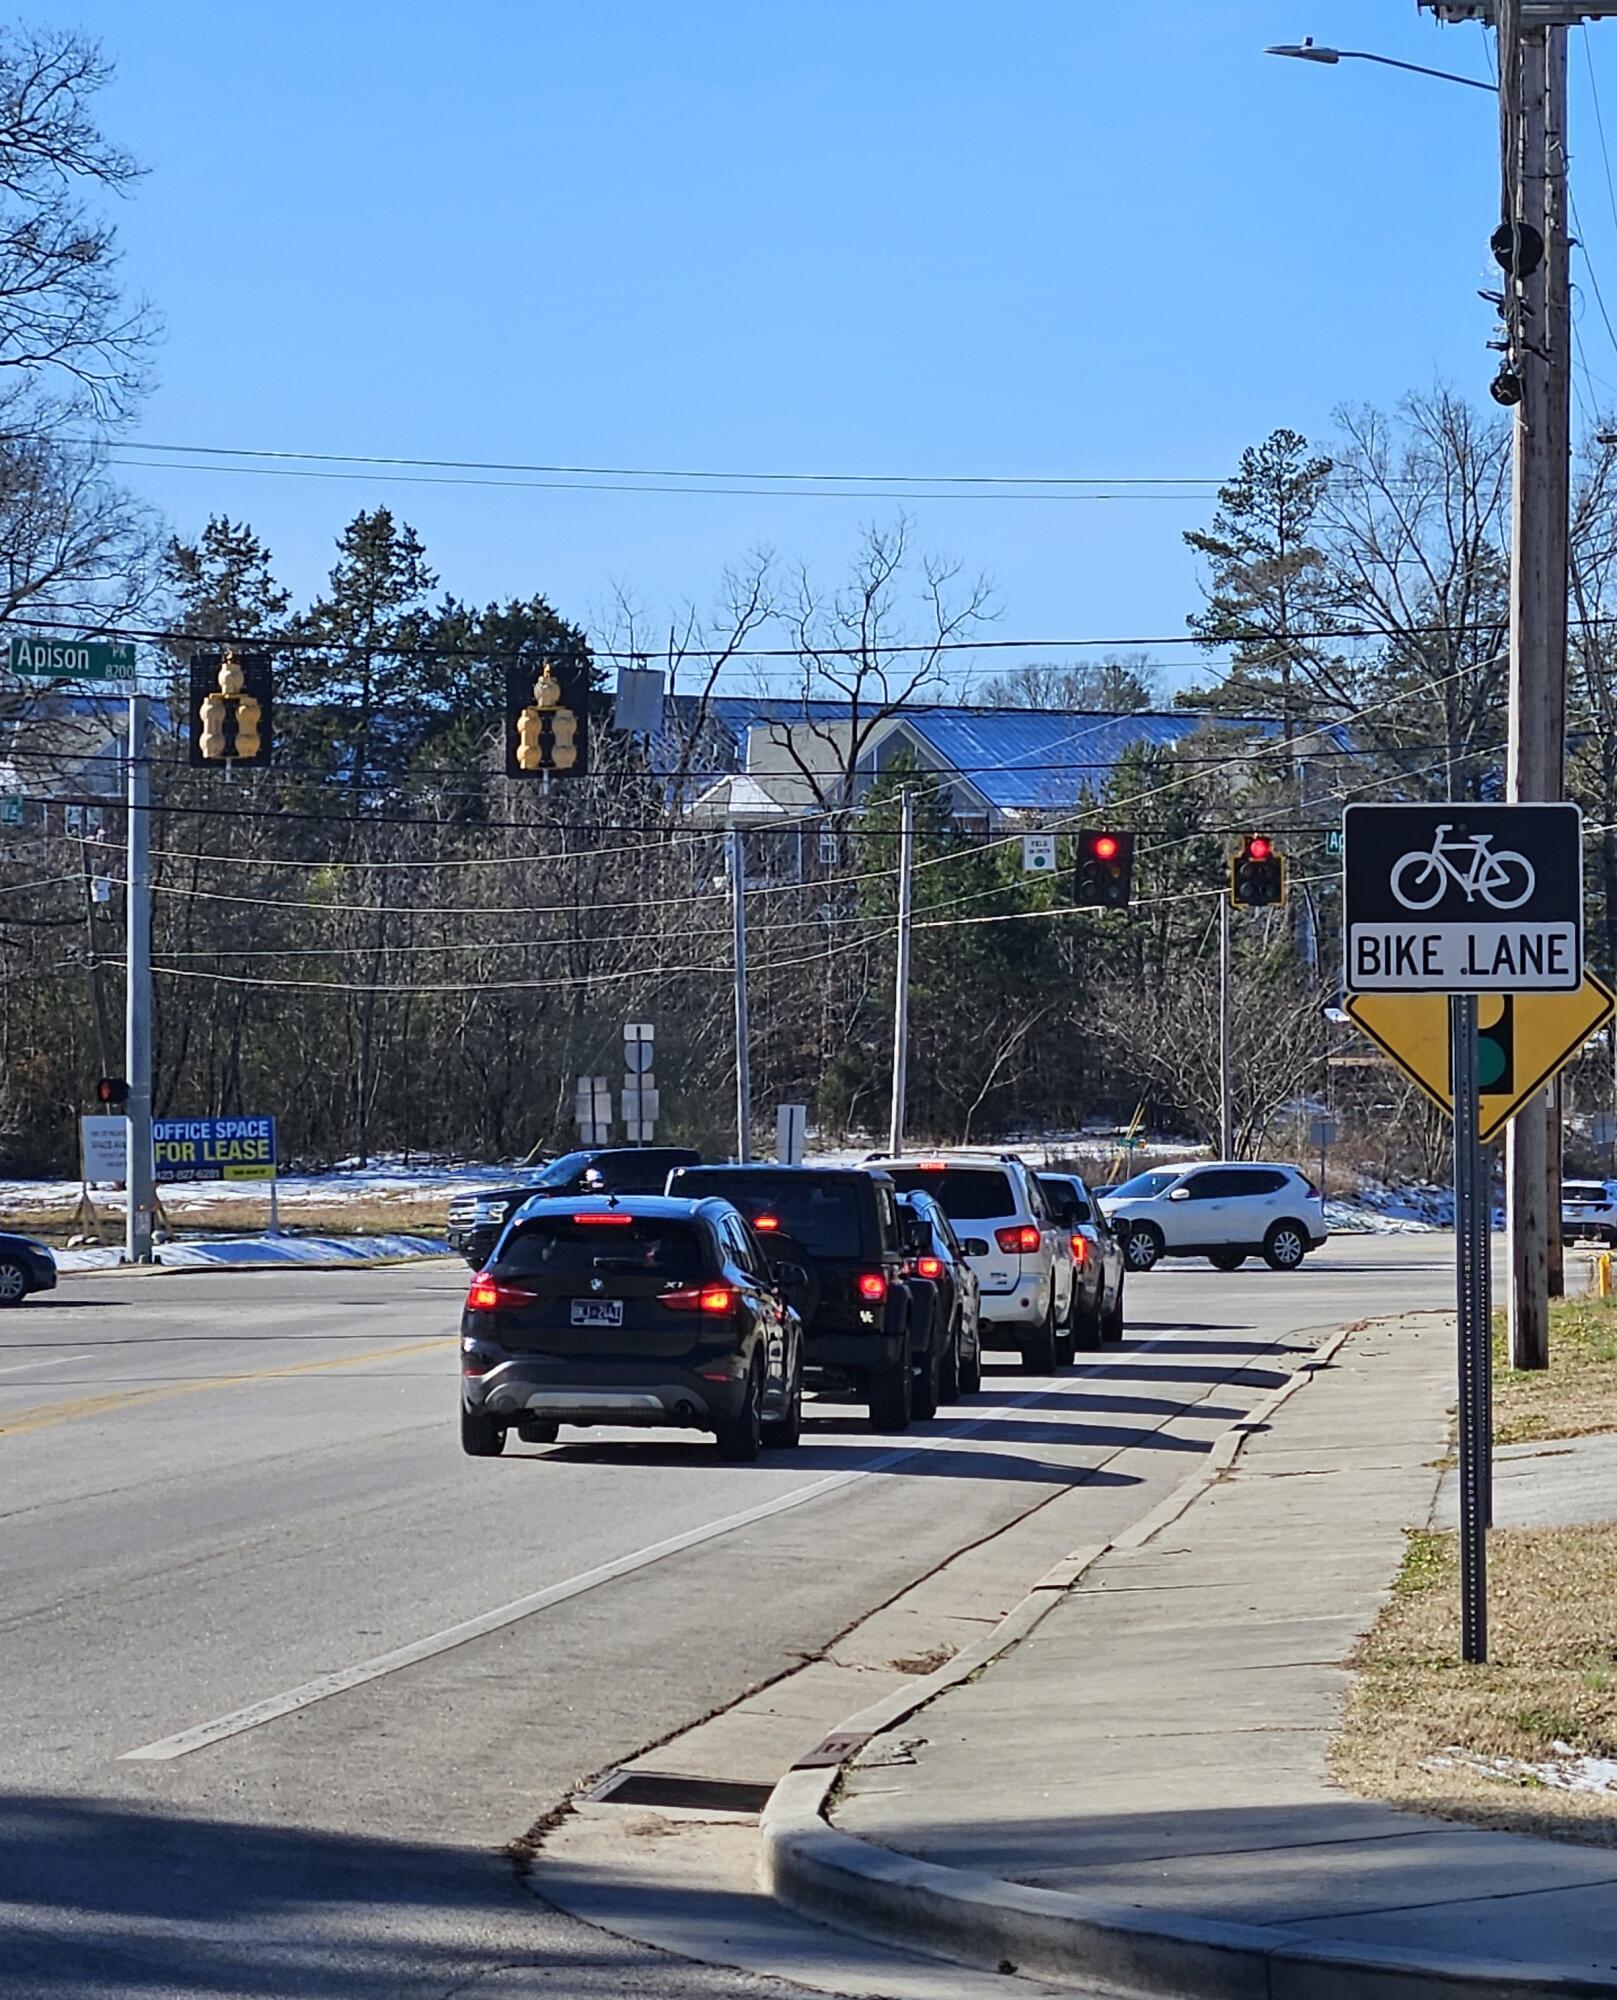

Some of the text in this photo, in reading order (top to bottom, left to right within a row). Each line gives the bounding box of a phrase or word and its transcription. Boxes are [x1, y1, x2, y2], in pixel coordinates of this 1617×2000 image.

[17, 640, 89, 674] Apison
[105, 664, 134, 679] 8200
[1358, 933, 1569, 976] BIKE LANE
[154, 1120, 269, 1141] OFFICE SPACE
[155, 1138, 270, 1163] FOR LEASE
